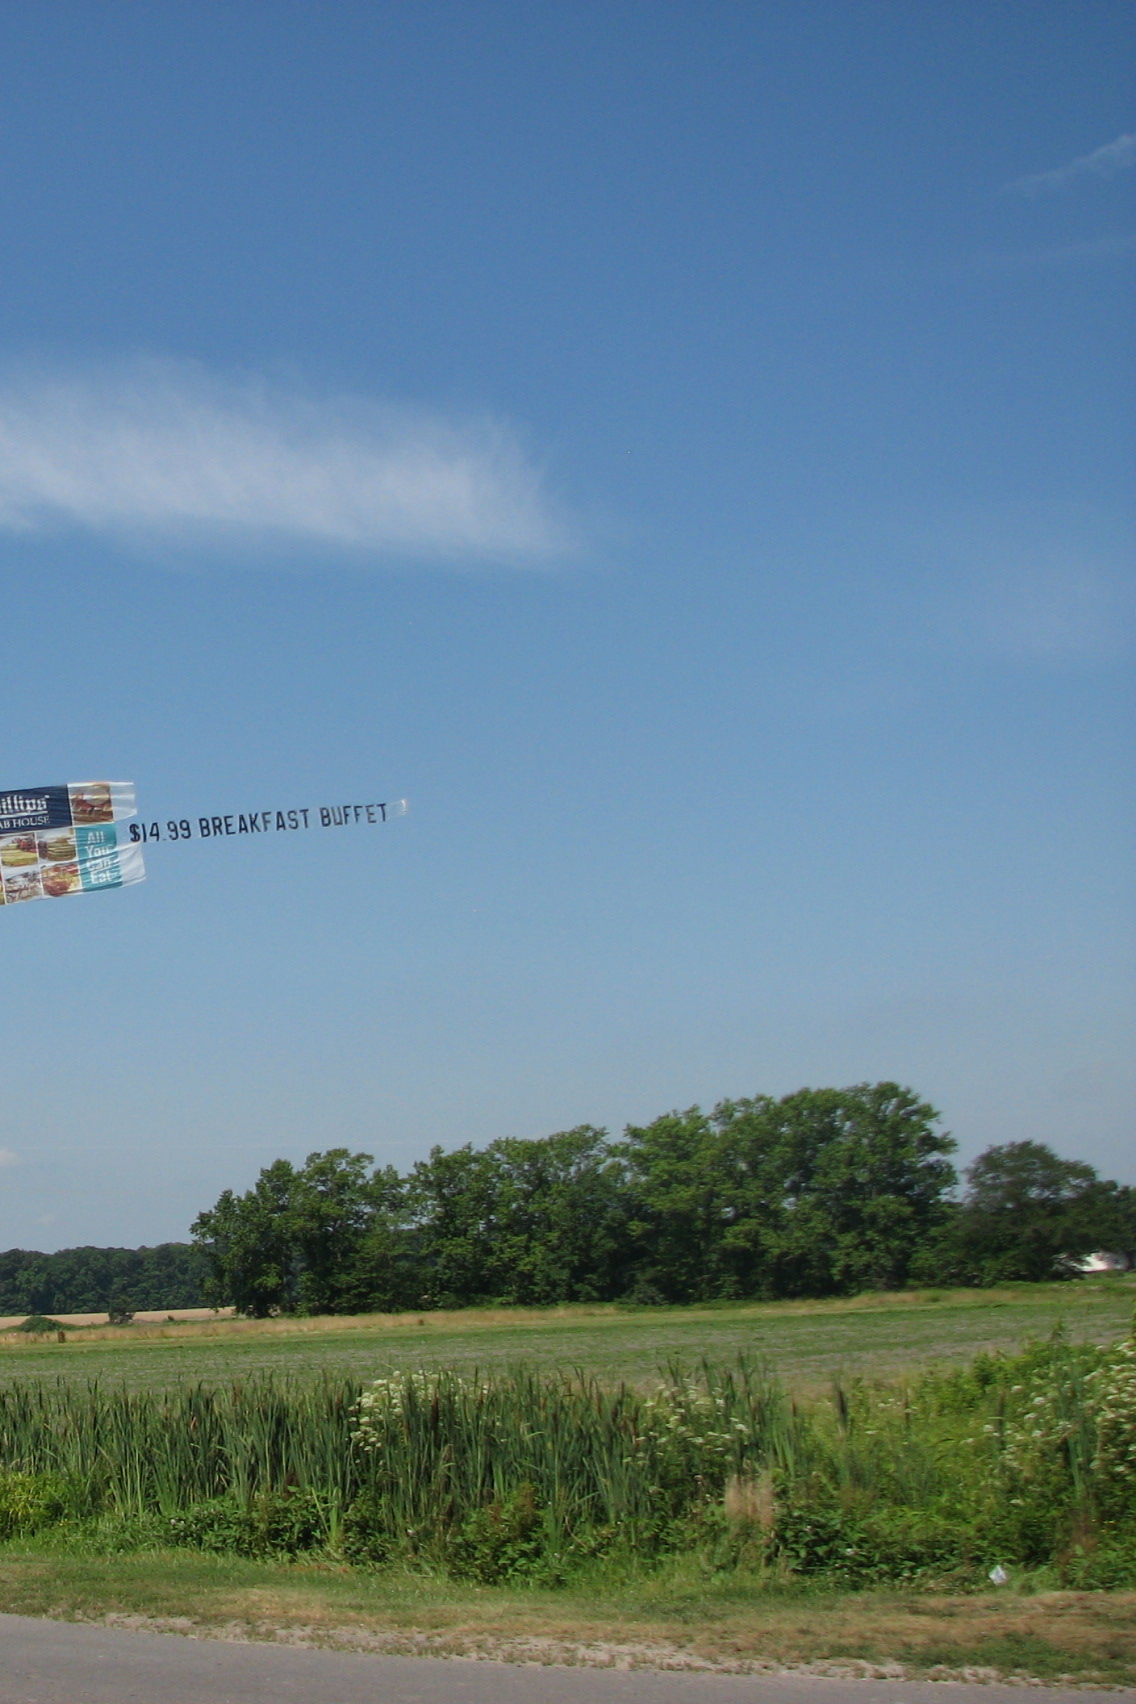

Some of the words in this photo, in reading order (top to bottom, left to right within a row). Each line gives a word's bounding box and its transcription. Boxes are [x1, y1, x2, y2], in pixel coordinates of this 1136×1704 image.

[13, 815, 51, 828] HOUSE
[129, 820, 192, 843] $14.99
[198, 809, 310, 838] BREAKFAST
[319, 803, 387, 827] BUFFET
[87, 831, 105, 844] All
[85, 845, 109, 858] You
[90, 870, 112, 884] Eat
